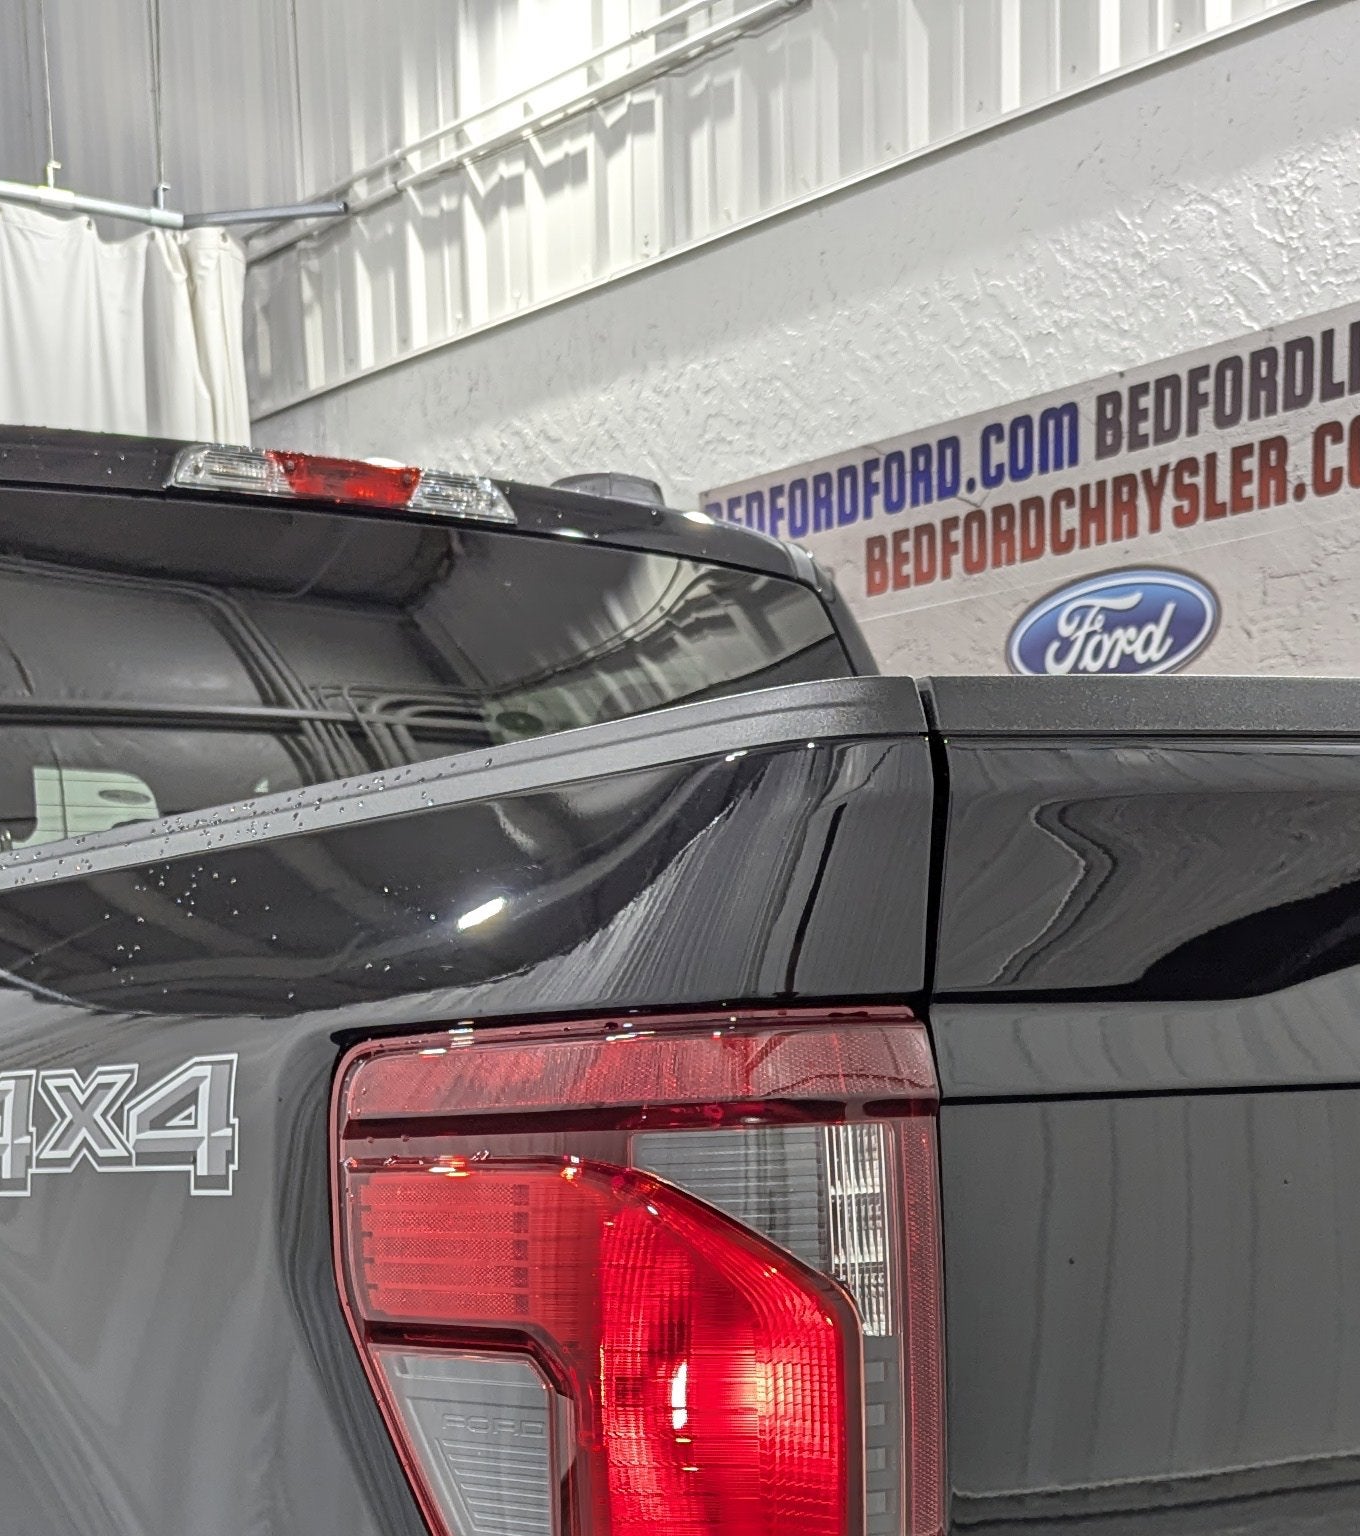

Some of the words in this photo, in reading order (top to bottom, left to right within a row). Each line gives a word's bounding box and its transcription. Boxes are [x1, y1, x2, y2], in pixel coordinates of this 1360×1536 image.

[703, 402, 1079, 540] EDFORDFORD.COM
[1045, 591, 1176, 675] Ford
[441, 1413, 547, 1439] FORD
